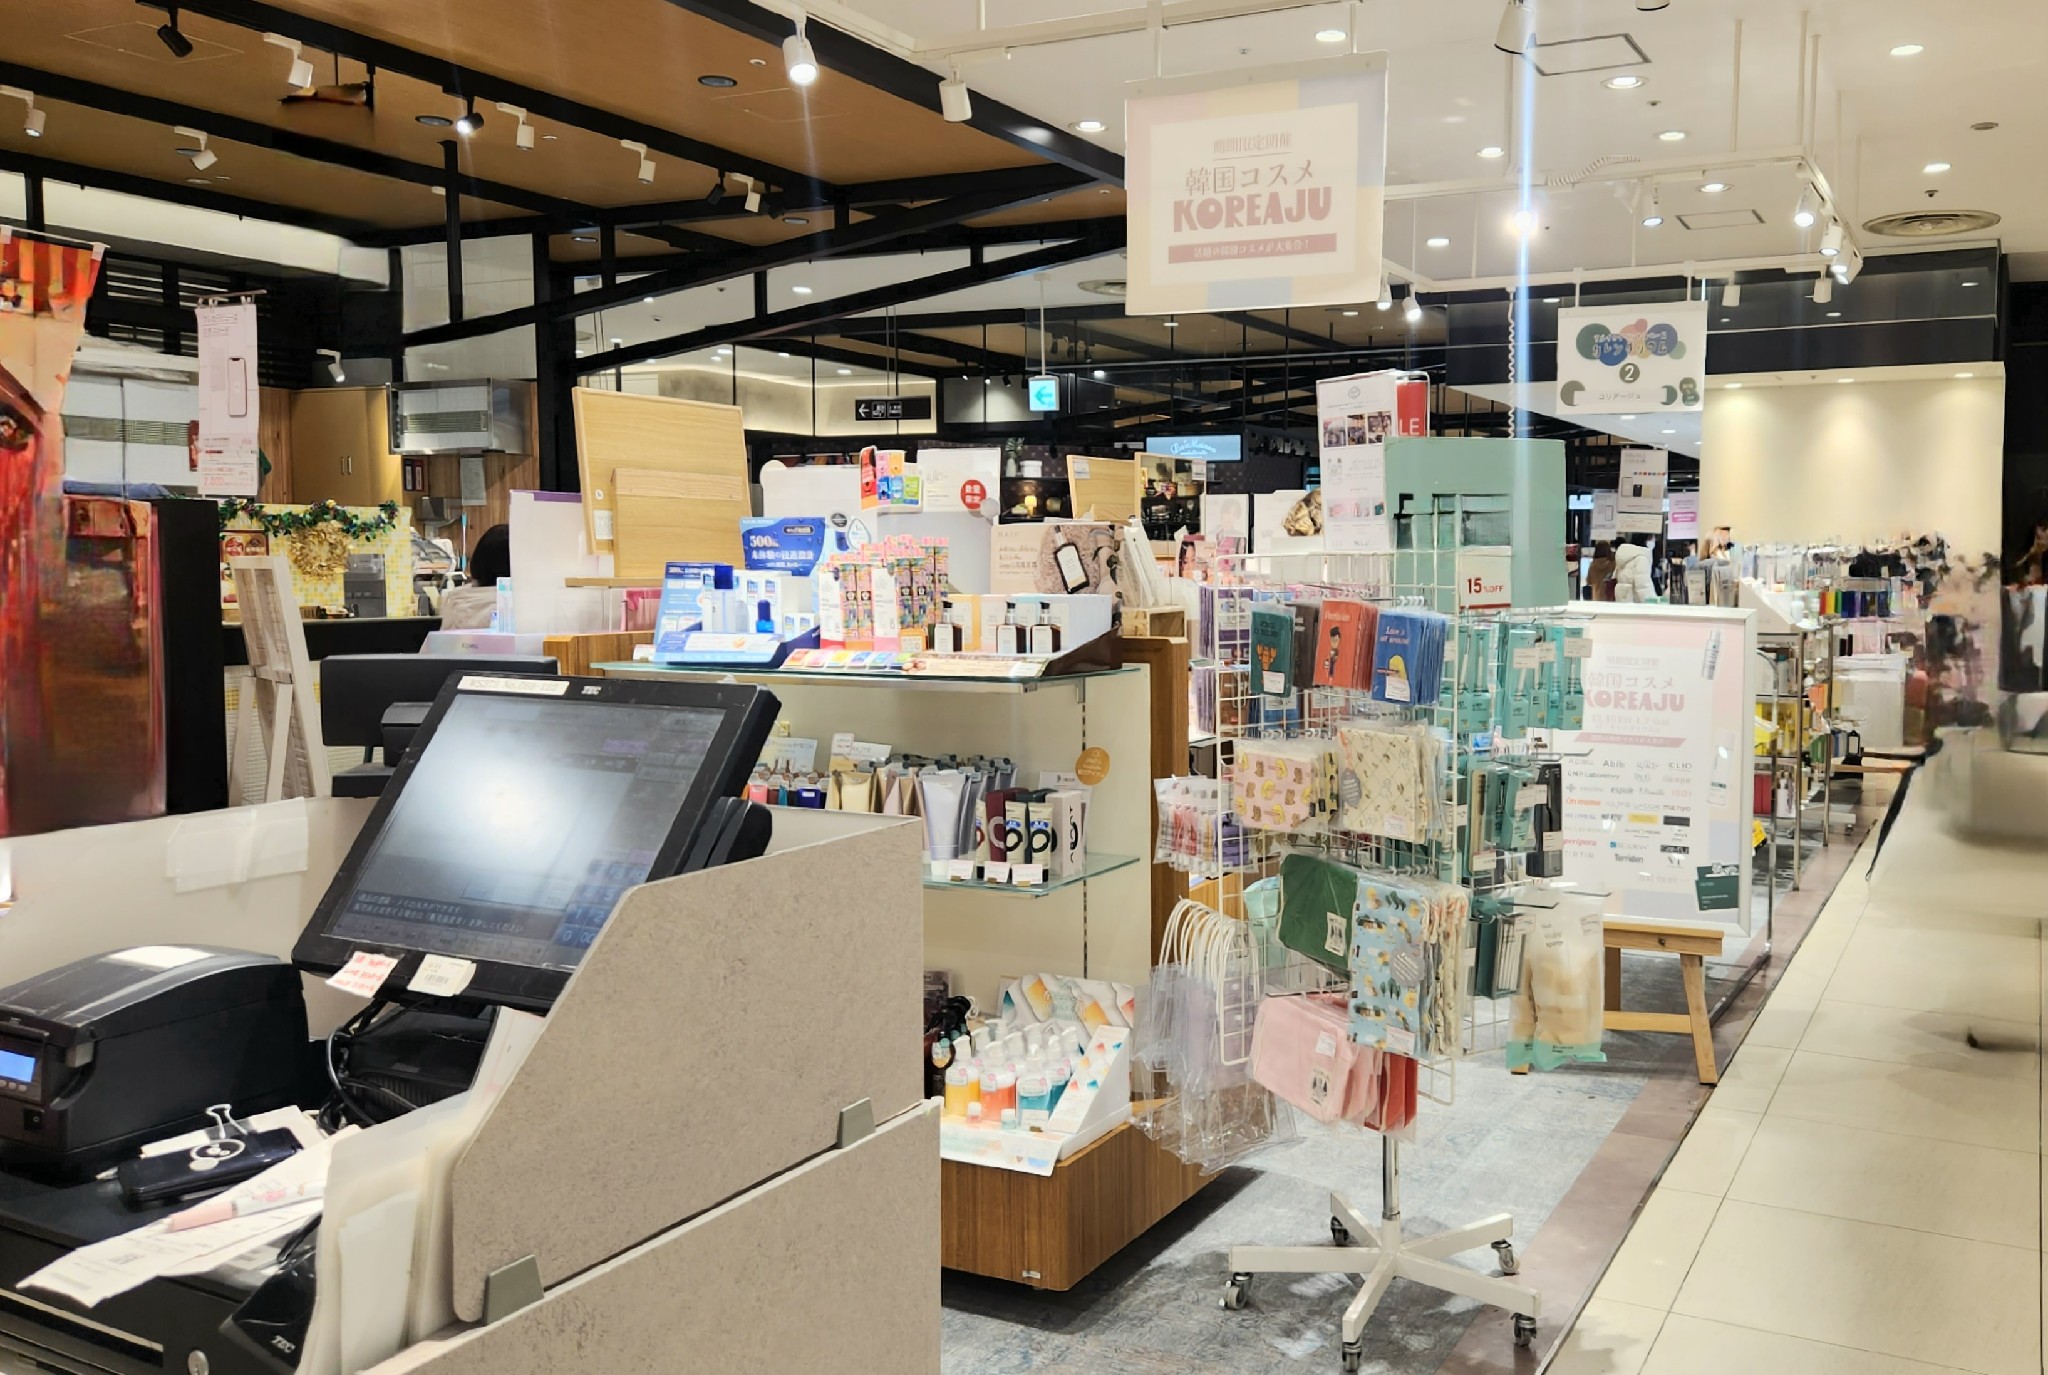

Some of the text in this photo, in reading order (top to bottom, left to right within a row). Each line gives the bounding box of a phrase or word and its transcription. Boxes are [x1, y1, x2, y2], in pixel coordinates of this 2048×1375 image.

[1185, 159, 1314, 196] 韓国コスメ
[1173, 186, 1332, 232] KOREAJU
[1624, 365, 1635, 381] 2
[1401, 418, 1421, 436] LE
[1588, 672, 1674, 689] 韓国コスメ
[1667, 762, 1693, 770] CLIO
[271, 1334, 297, 1354] TEC
